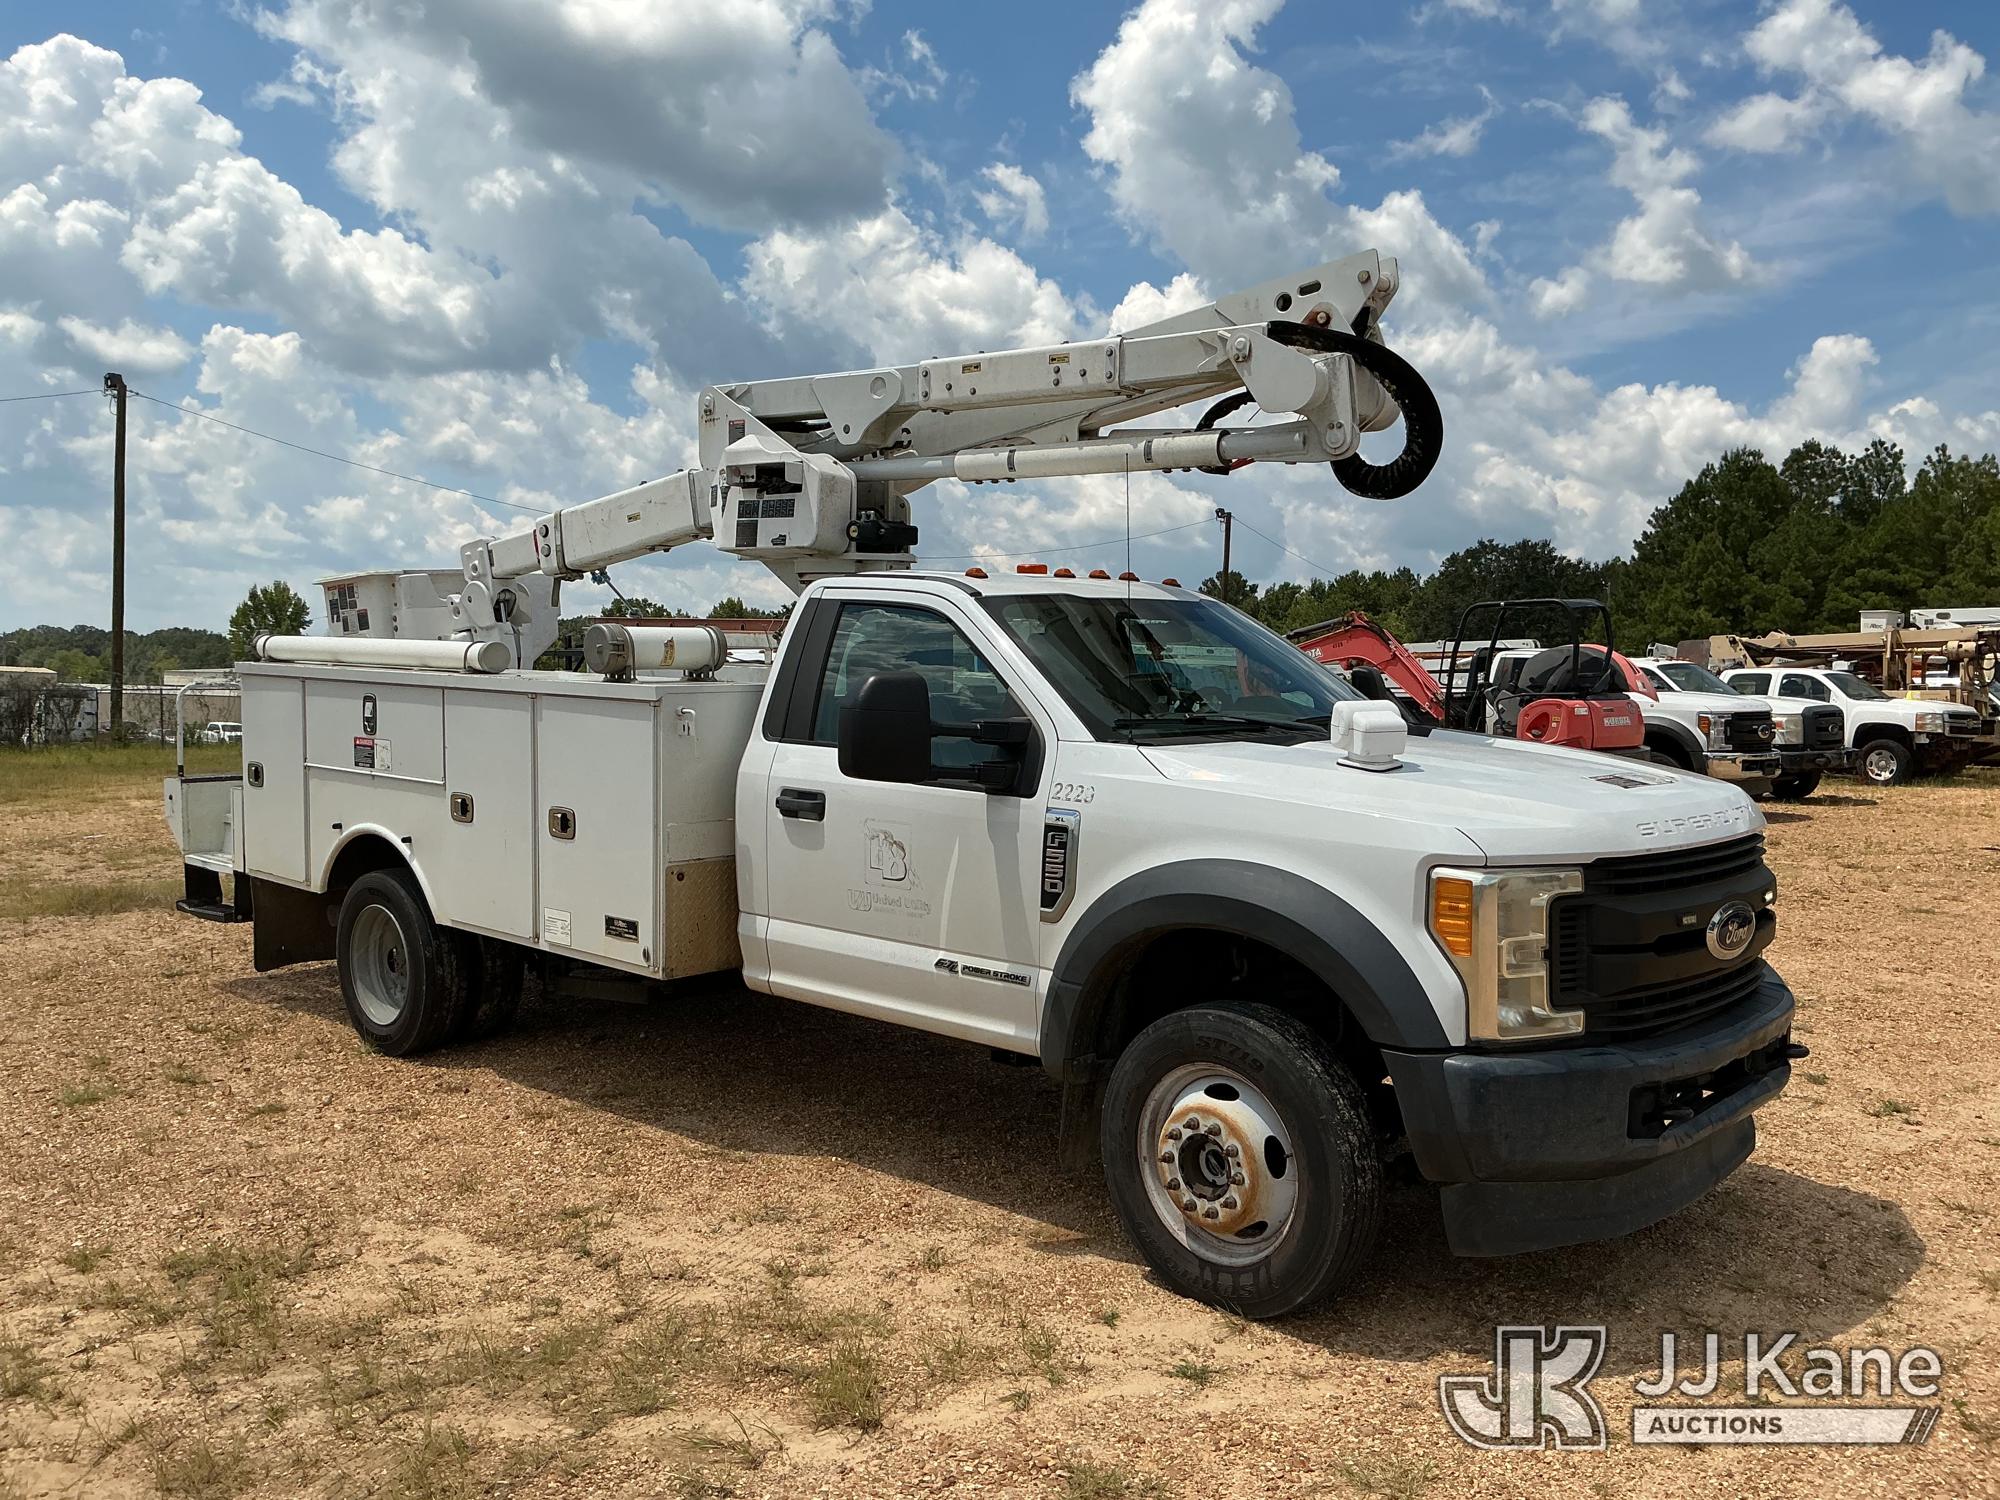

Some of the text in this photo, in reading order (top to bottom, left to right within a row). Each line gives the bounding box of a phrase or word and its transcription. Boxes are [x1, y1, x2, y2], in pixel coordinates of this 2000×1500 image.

[1636, 814, 1714, 838] SUPER
[1725, 918, 1749, 945] Ford
[962, 964, 992, 976] POWER
[992, 970, 1028, 983] STROKE
